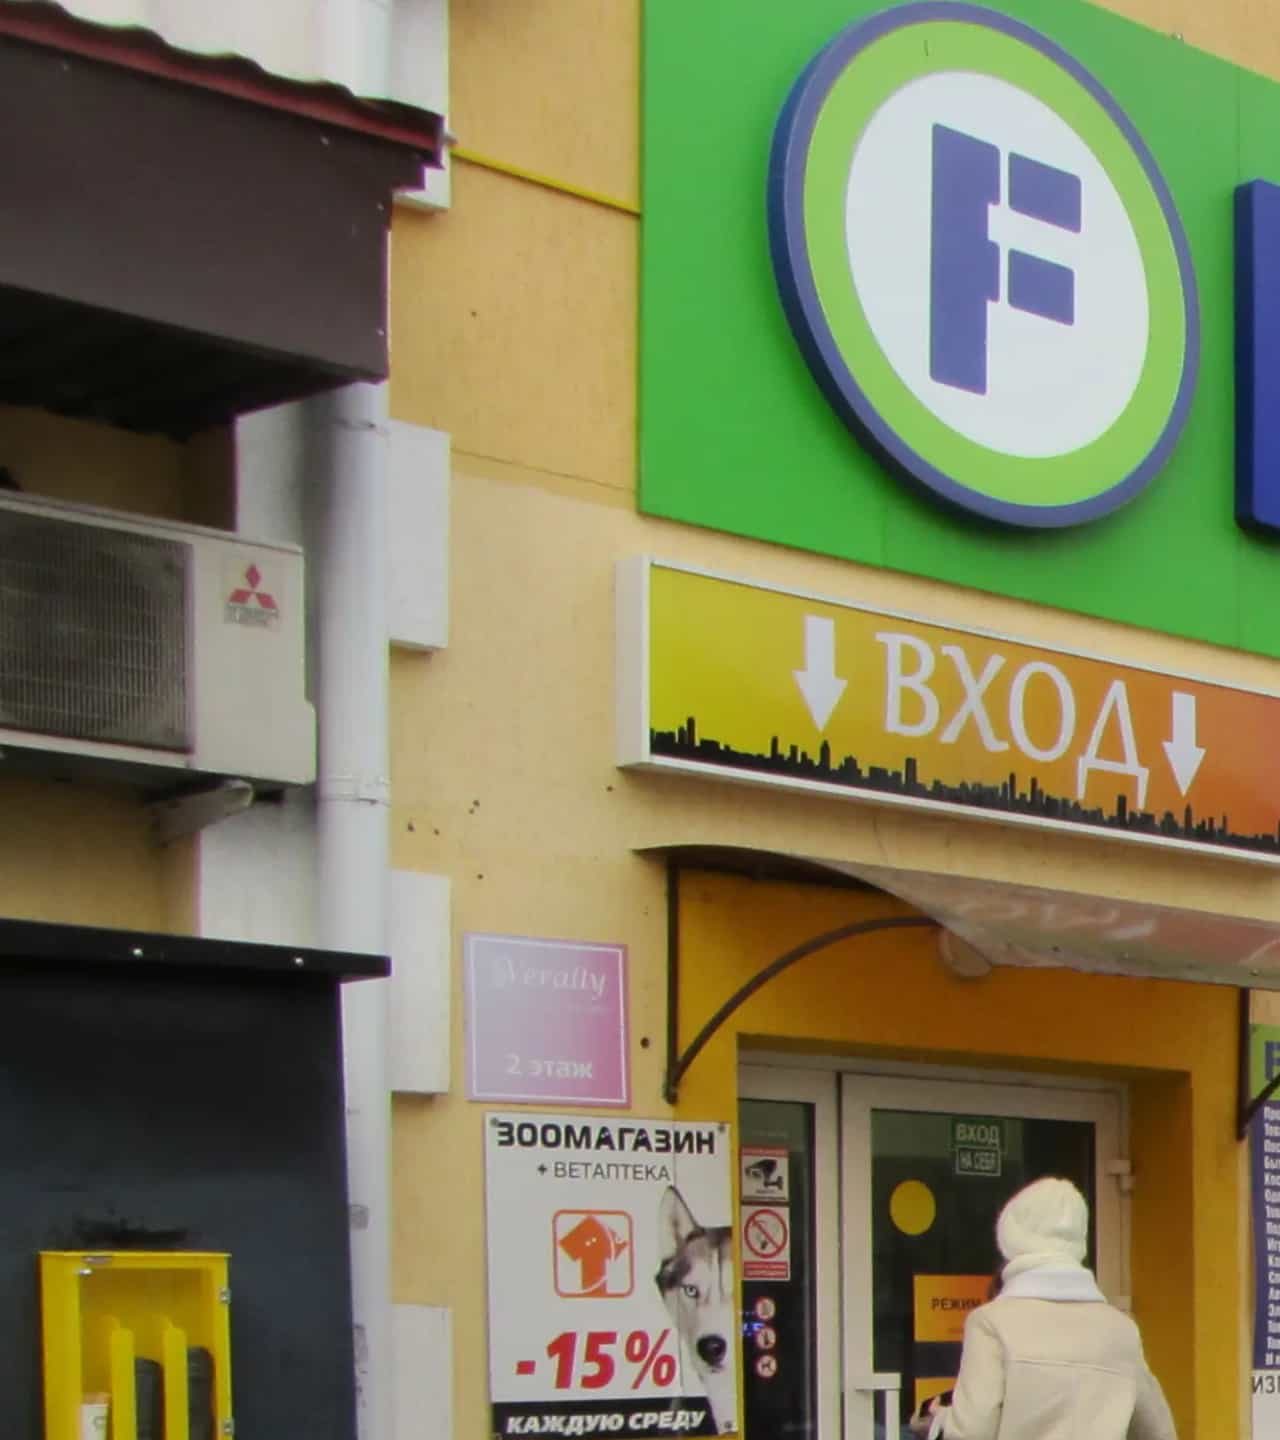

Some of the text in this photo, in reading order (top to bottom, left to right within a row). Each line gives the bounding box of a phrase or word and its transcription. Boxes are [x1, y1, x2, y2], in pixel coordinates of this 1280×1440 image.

[929, 122, 1081, 396] F
[875, 632, 1149, 809] ВХОД
[504, 1052, 593, 1079] 2 этаж
[497, 1121, 716, 1154] ЗООМАГАЗИН
[955, 1122, 1000, 1145] ВХОД
[553, 1160, 671, 1181] ВЕТАПТЕКА
[515, 1328, 677, 1390] -15%
[506, 1409, 707, 1436] КАЖДУЮ СРЕДУ
